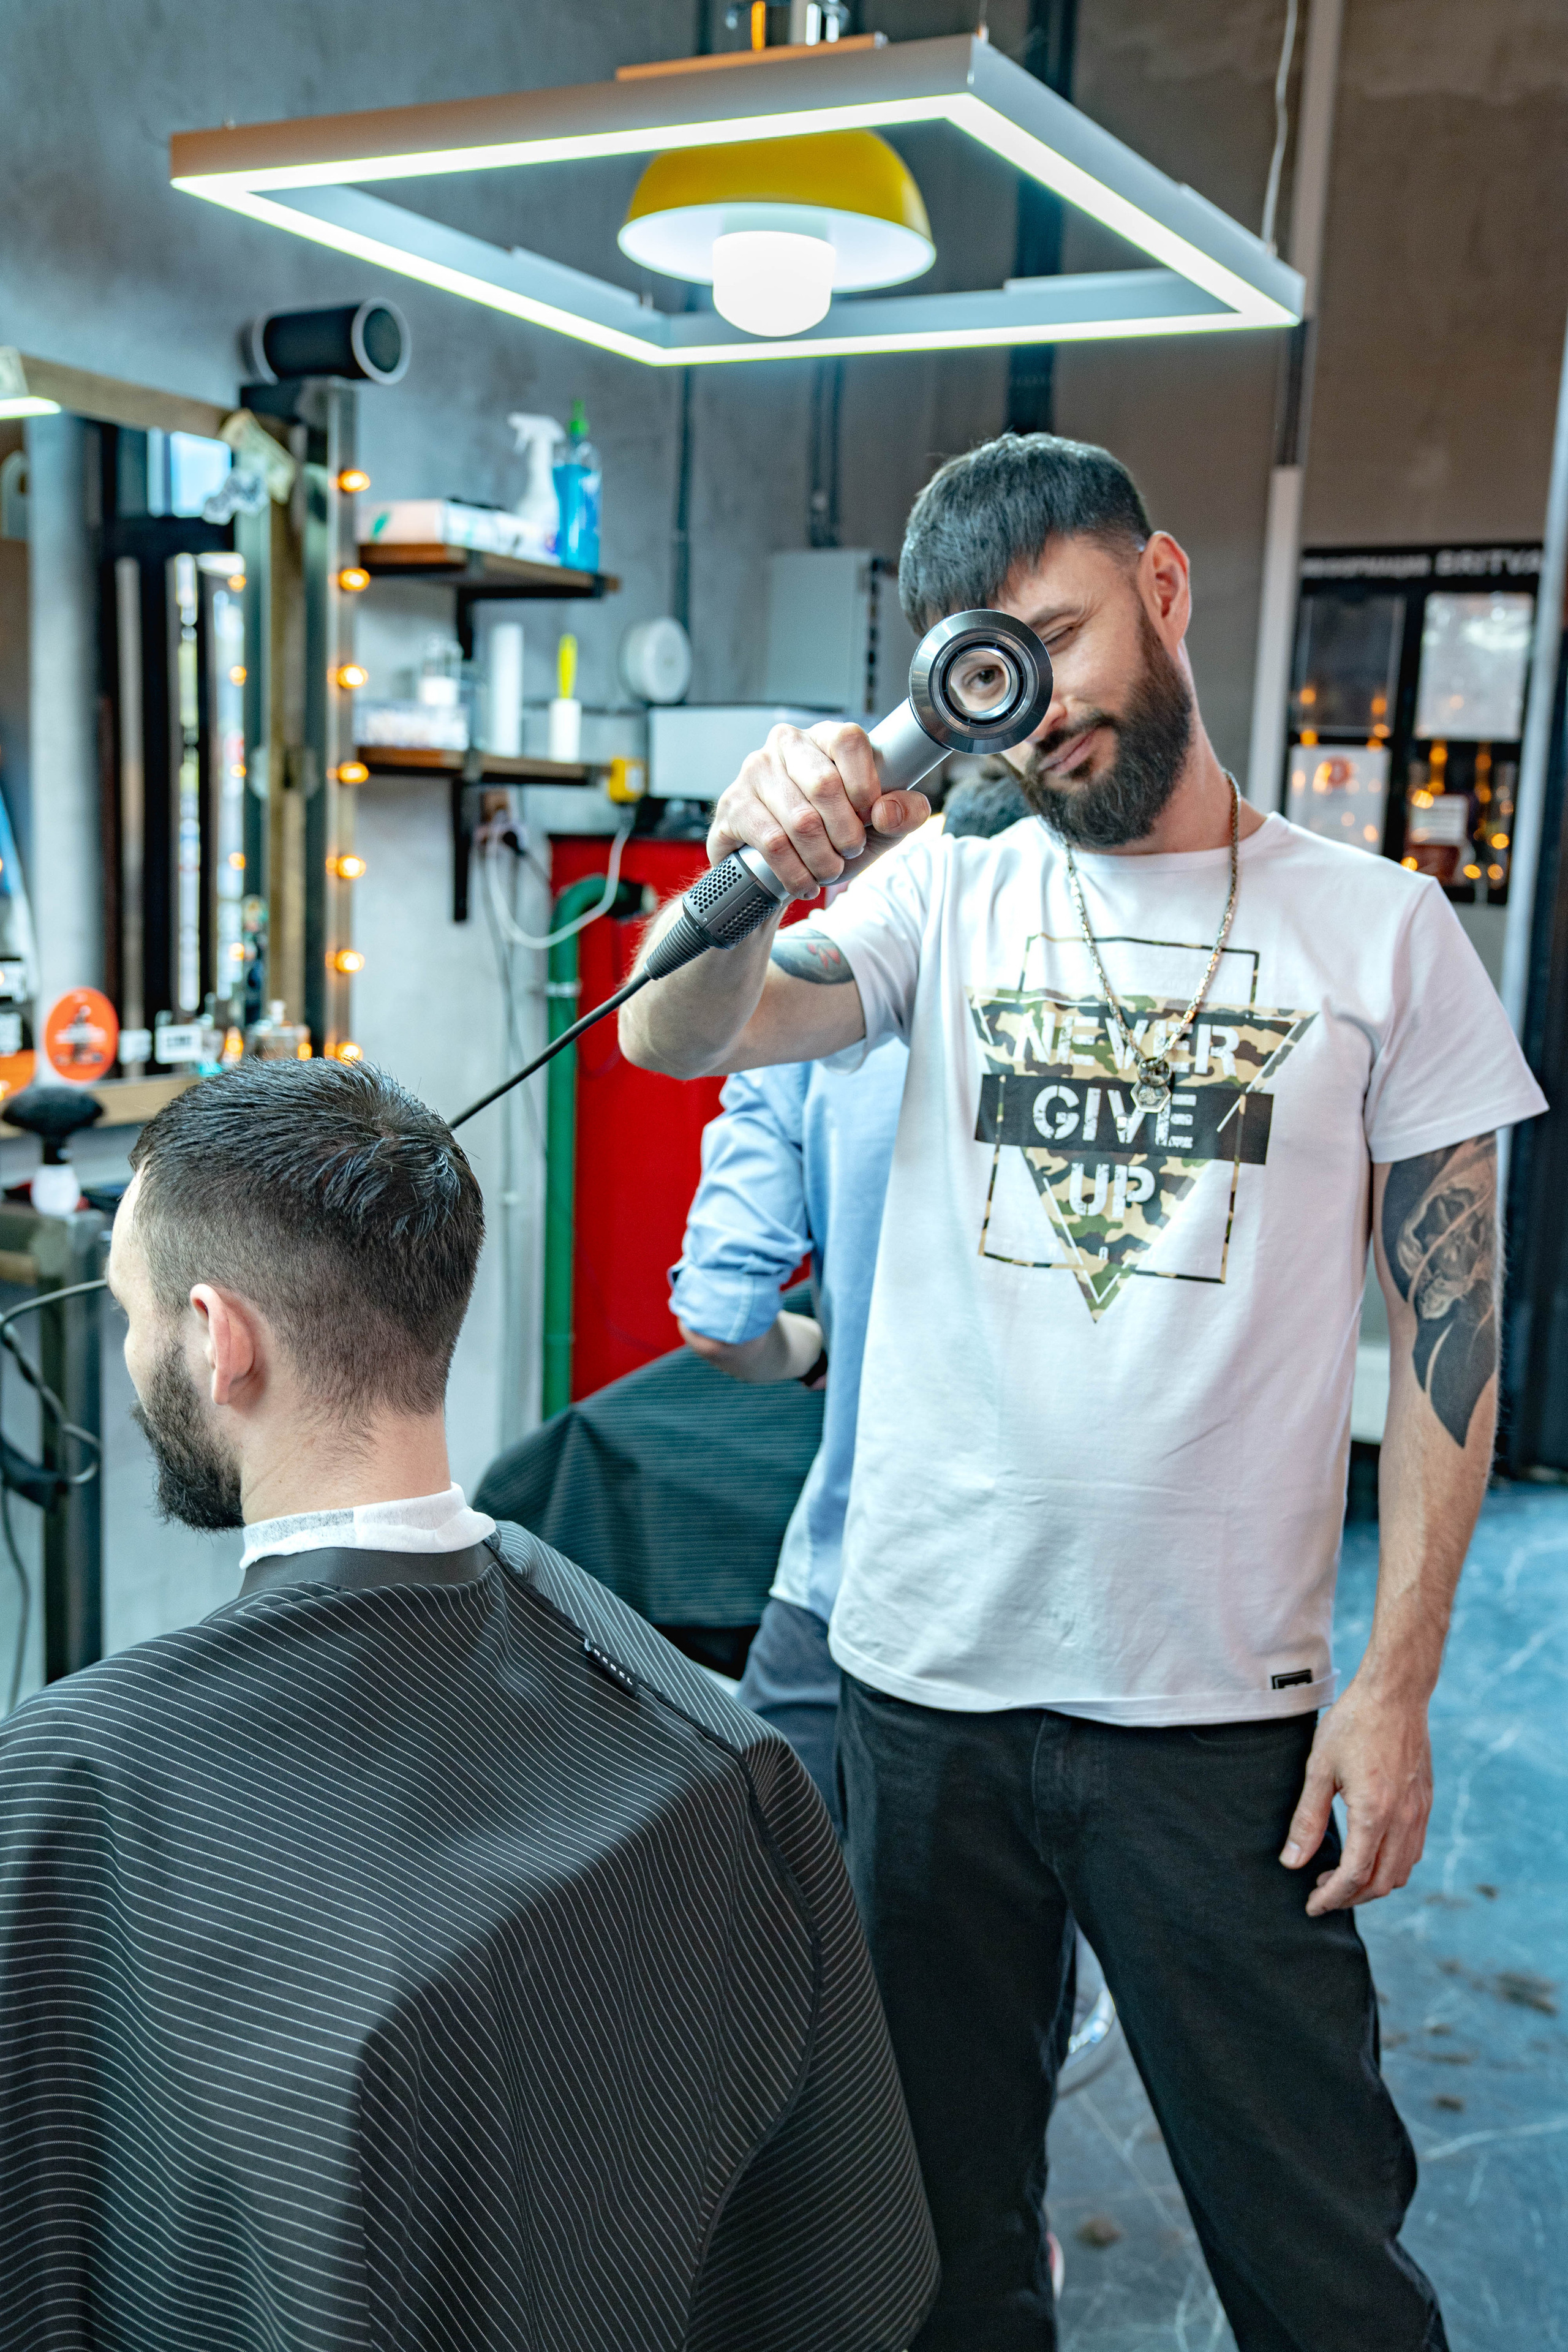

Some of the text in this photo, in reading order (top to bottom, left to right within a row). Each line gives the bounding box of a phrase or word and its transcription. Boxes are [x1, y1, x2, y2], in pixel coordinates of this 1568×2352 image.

[1012, 1011, 1240, 1077] NEVER
[1032, 1084, 1197, 1149] GIVE
[1068, 1162, 1155, 1218] UP
[594, 1648, 633, 1686] REBEL
